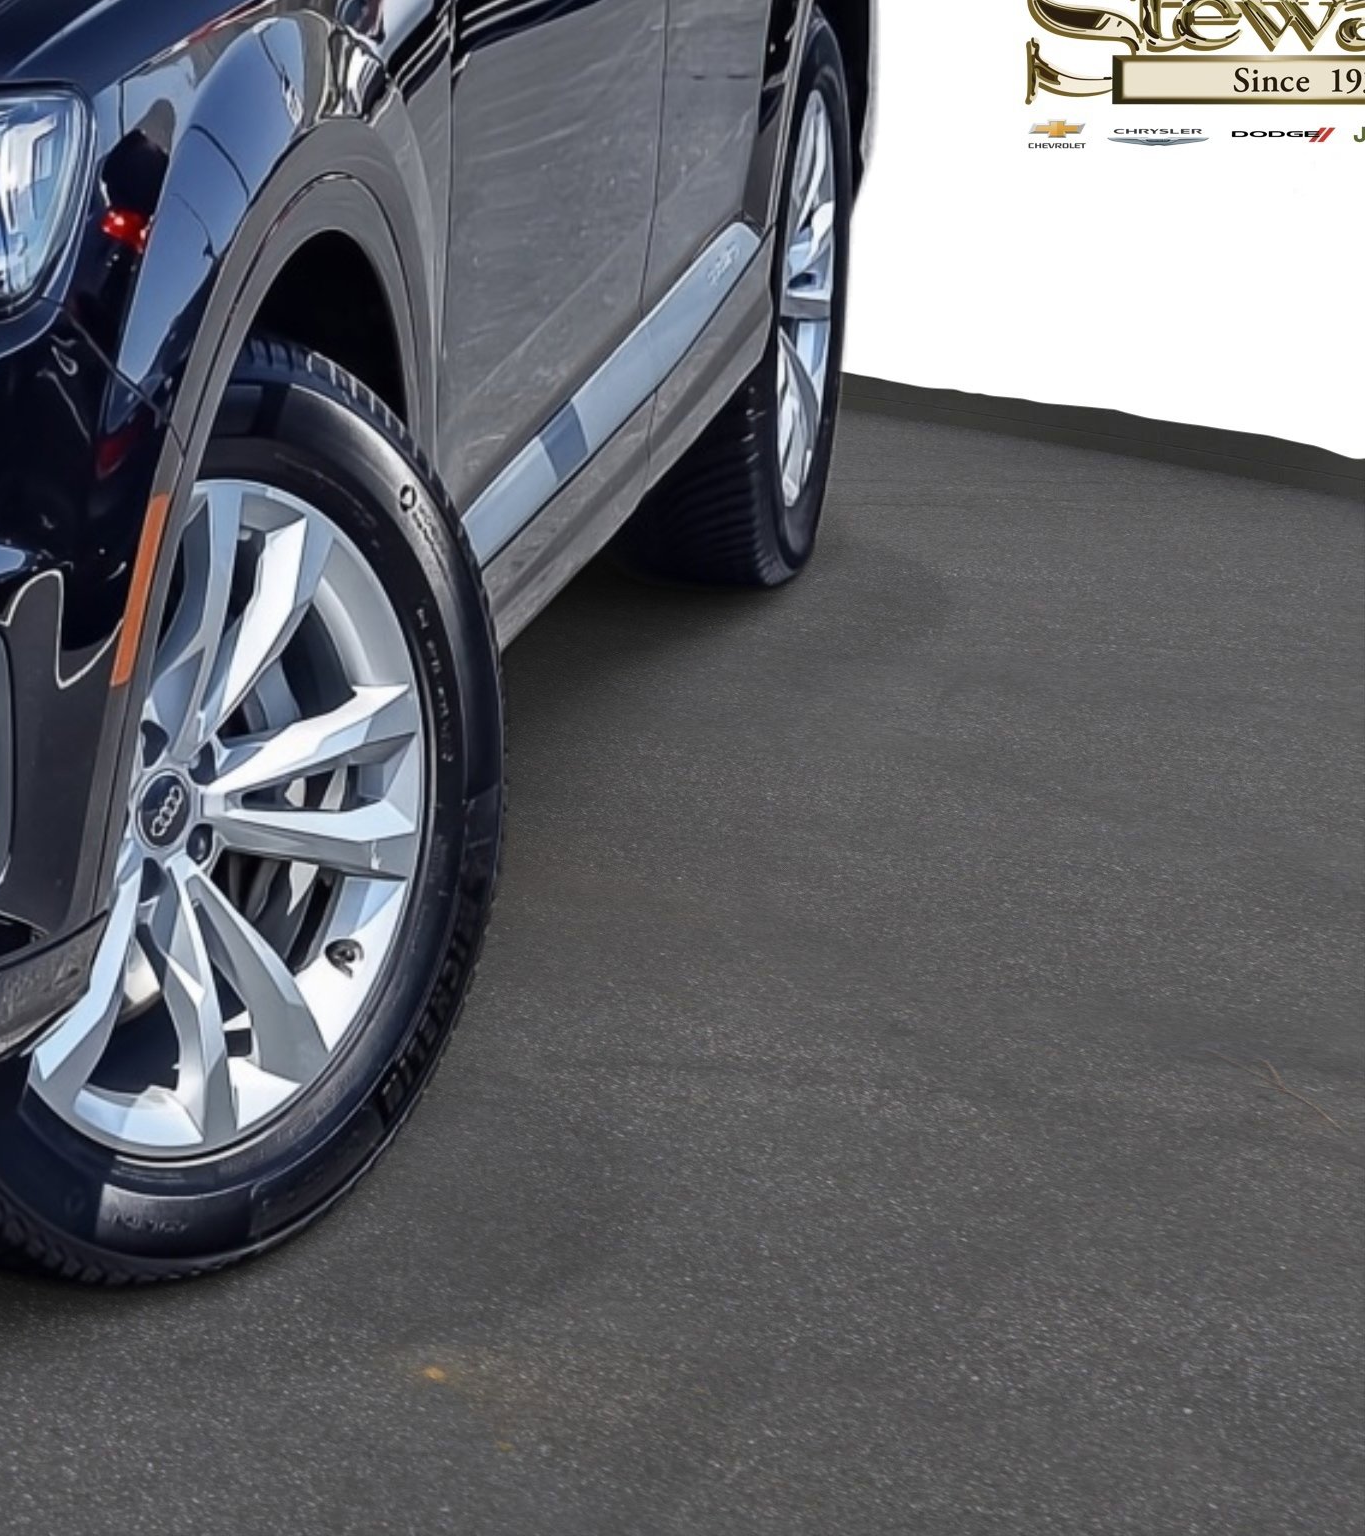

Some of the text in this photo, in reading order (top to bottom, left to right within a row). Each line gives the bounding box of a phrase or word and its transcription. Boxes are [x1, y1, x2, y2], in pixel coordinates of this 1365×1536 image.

[1233, 67, 1365, 94] Since 19
[1231, 129, 1319, 138] DODGE
